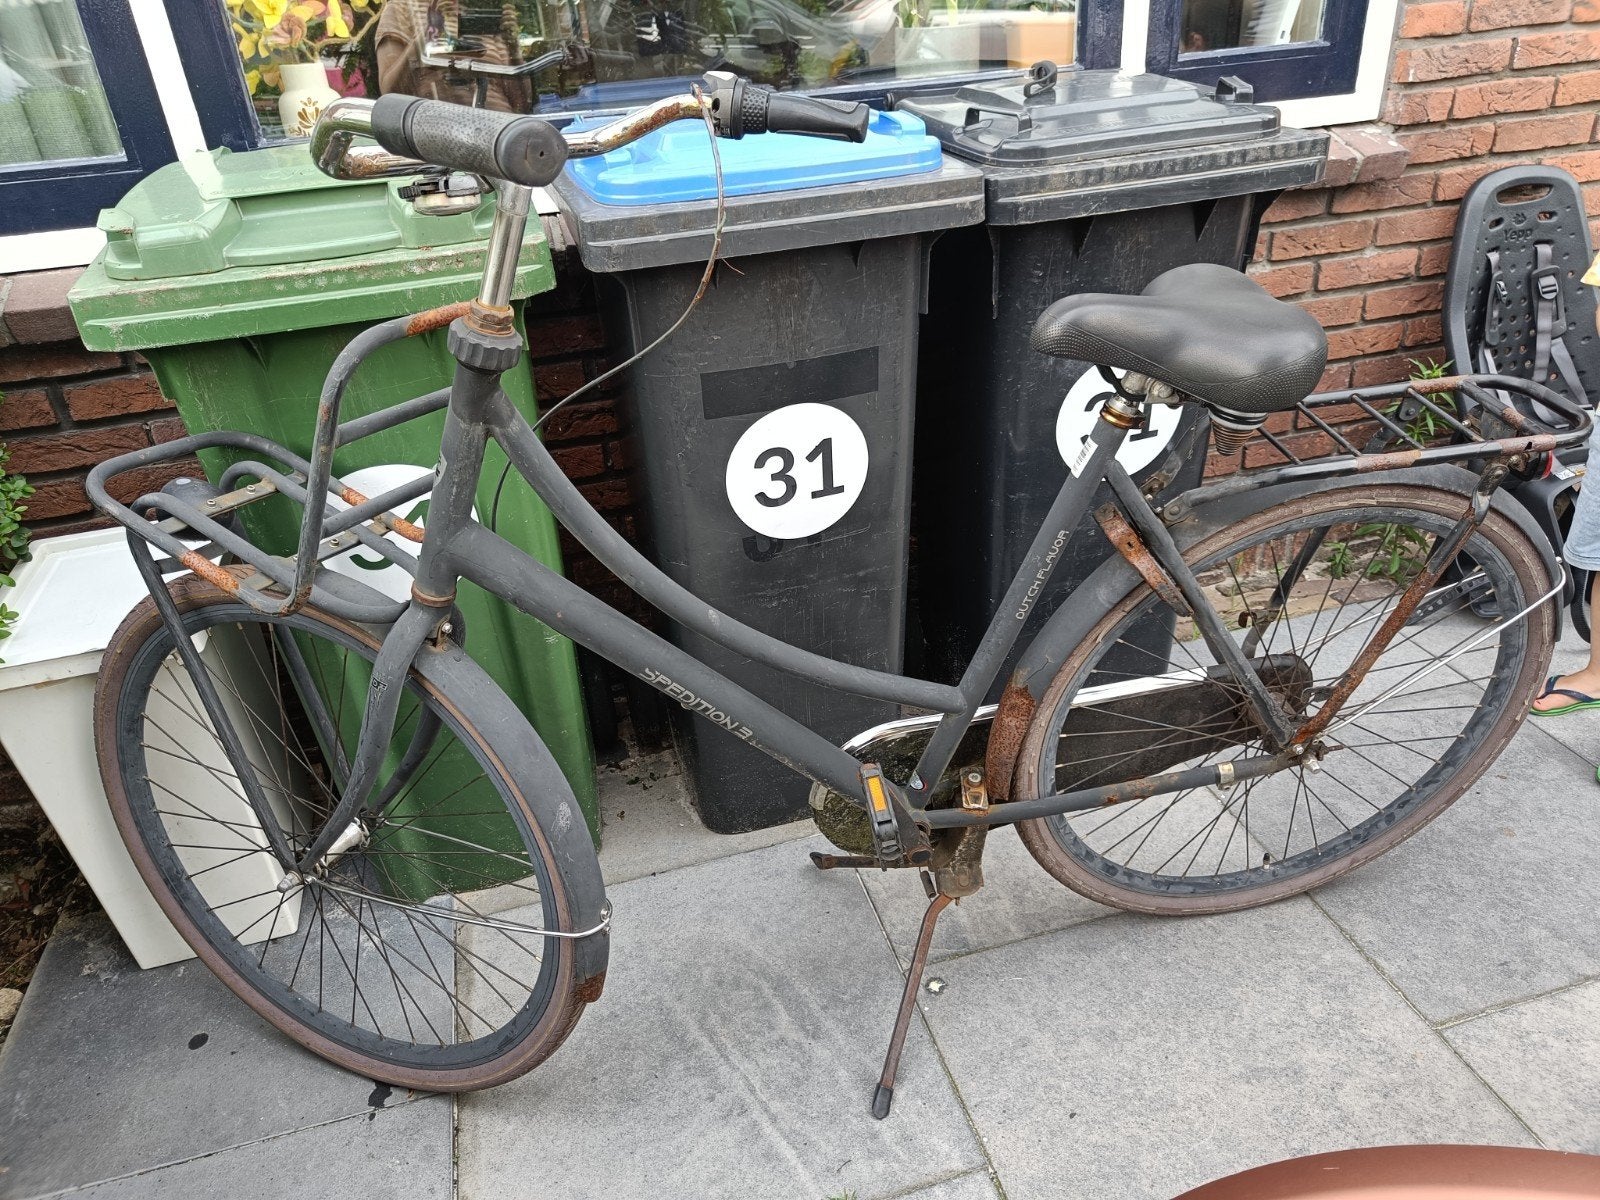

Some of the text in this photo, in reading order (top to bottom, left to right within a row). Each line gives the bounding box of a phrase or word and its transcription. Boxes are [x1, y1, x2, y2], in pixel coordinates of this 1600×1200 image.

[1503, 228, 1533, 242] Yepp
[753, 437, 845, 508] 31
[1015, 580, 1042, 620] DUTCH
[734, 726, 754, 741] 3
